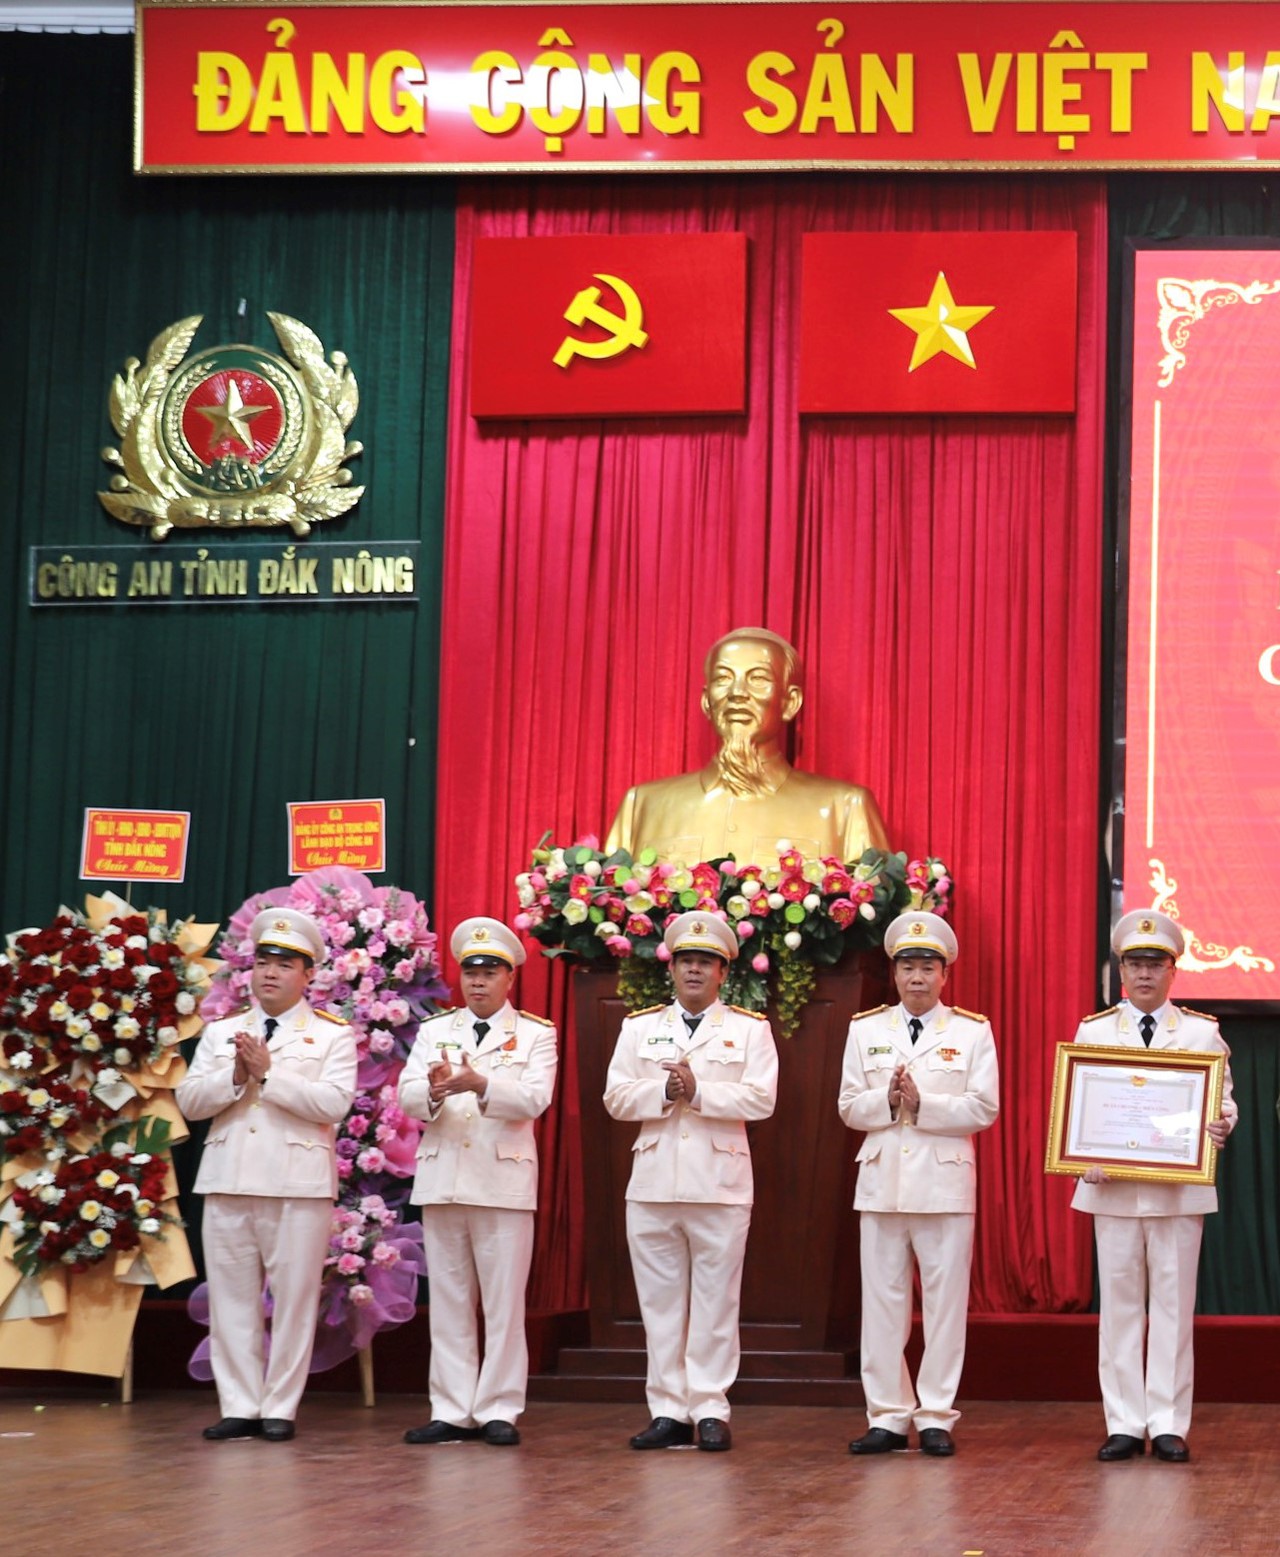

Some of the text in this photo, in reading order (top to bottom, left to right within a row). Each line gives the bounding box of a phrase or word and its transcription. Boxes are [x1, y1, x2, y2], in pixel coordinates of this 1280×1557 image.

[193, 18, 427, 134] ĐẢNG
[469, 28, 701, 152] CỘNG
[743, 18, 913, 134] SẢN
[959, 30, 1148, 149] VIỆT
[37, 545, 414, 597] CÔNG AN TỈNH ĐẮK NÔNG
